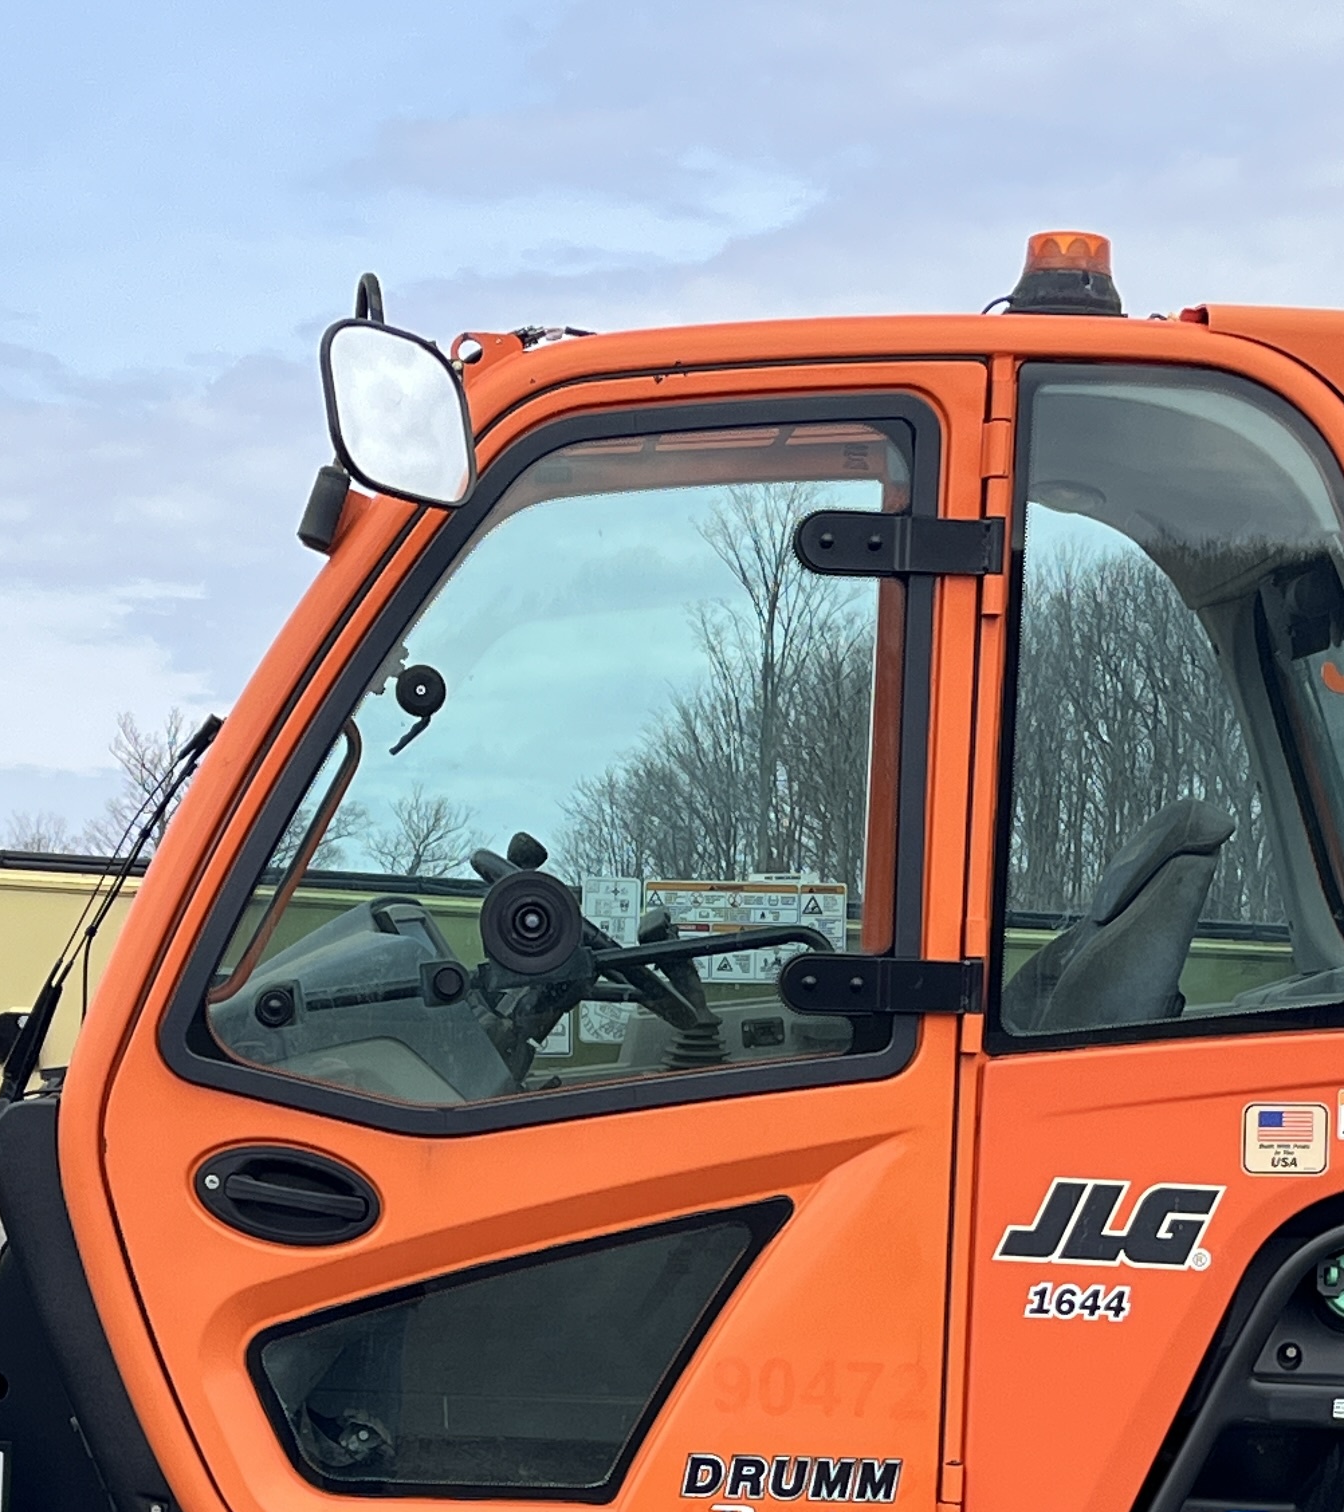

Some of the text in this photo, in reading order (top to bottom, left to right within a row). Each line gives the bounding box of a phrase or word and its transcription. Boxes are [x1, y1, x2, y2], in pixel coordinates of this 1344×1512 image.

[1270, 1157, 1298, 1168] USA
[993, 1177, 1226, 1270] JLG
[1025, 1283, 1129, 1320] 1644
[713, 1357, 929, 1420] 90472
[681, 1453, 903, 1503] DRUMM
